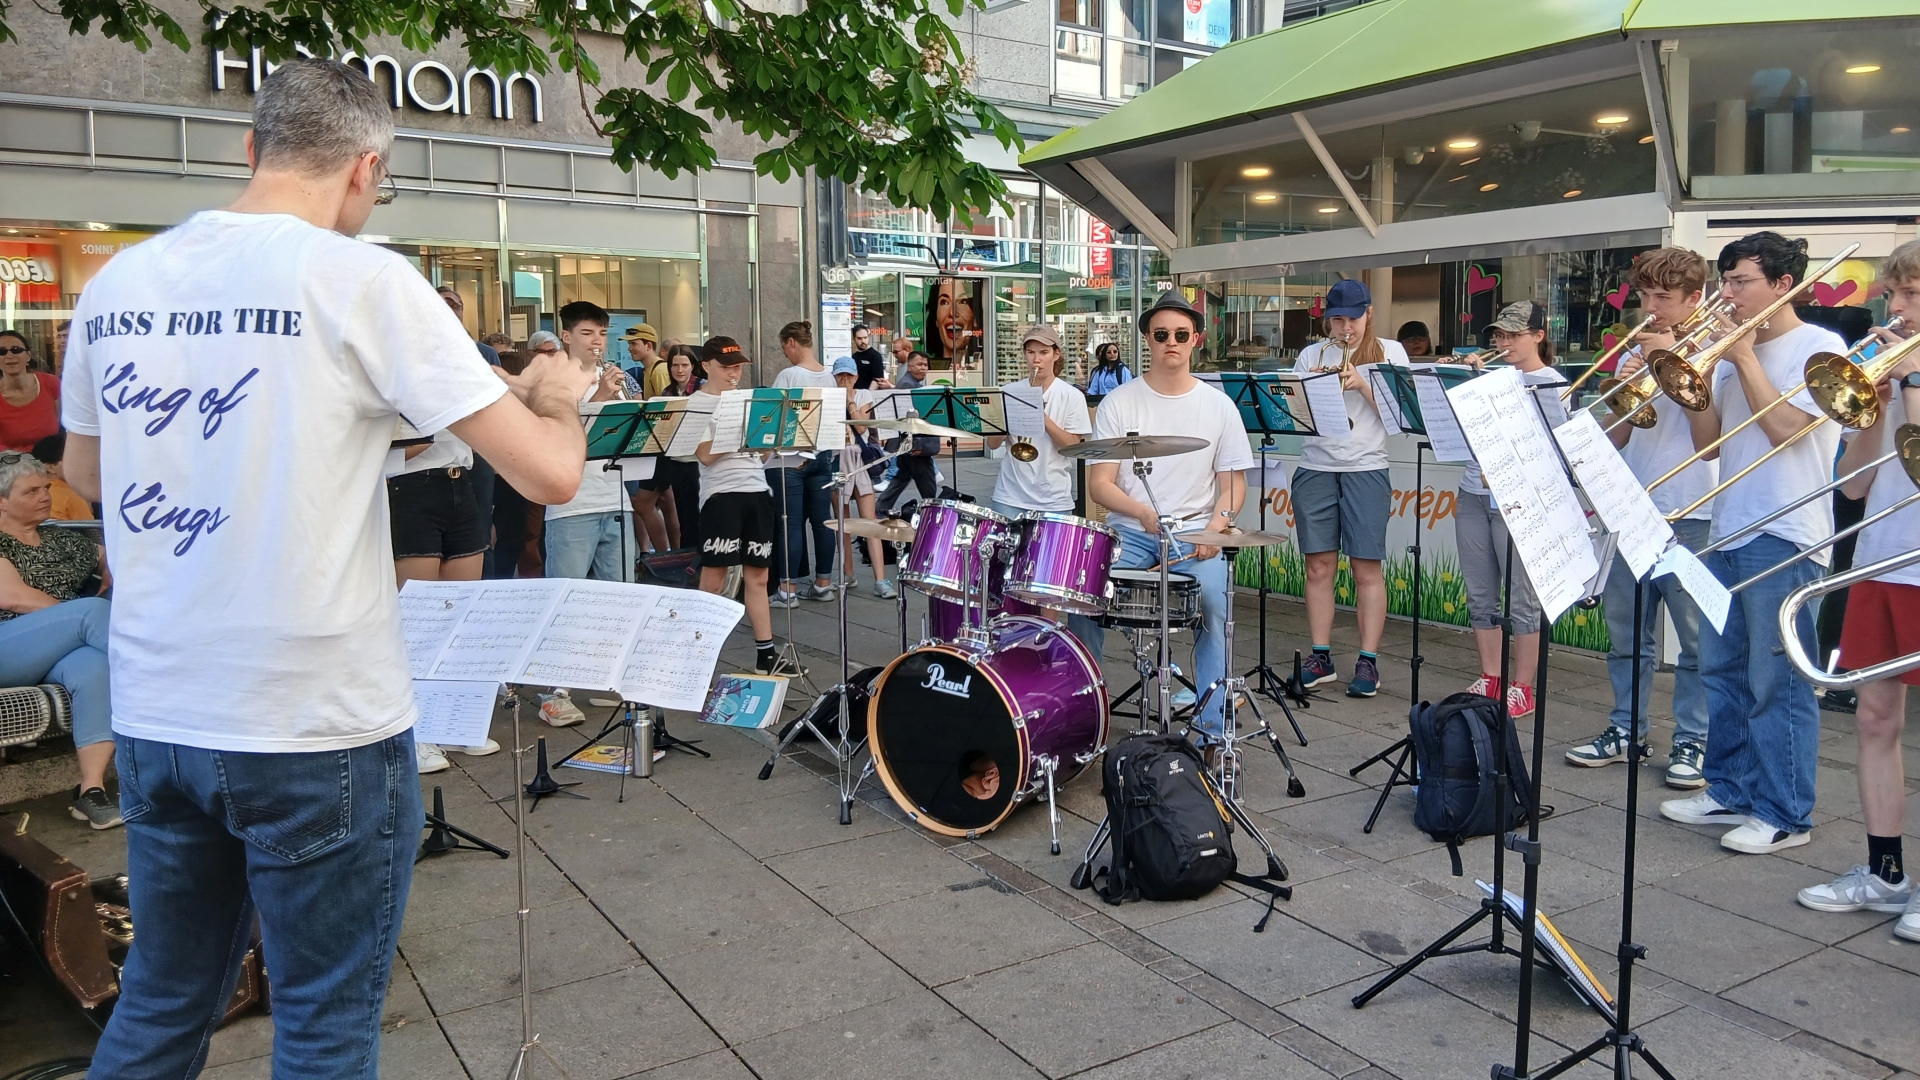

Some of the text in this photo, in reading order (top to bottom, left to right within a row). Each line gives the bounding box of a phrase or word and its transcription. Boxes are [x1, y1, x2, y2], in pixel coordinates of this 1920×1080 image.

[81, 244, 115, 255] SONNE
[828, 268, 845, 283] 66
[1069, 275, 1113, 290] pro optik
[1157, 280, 1173, 292] pro
[165, 311, 223, 336] FOR
[234, 308, 302, 337] THE
[102, 361, 260, 440] King of
[117, 482, 230, 557] Kings
[920, 663, 971, 696] Pearl
